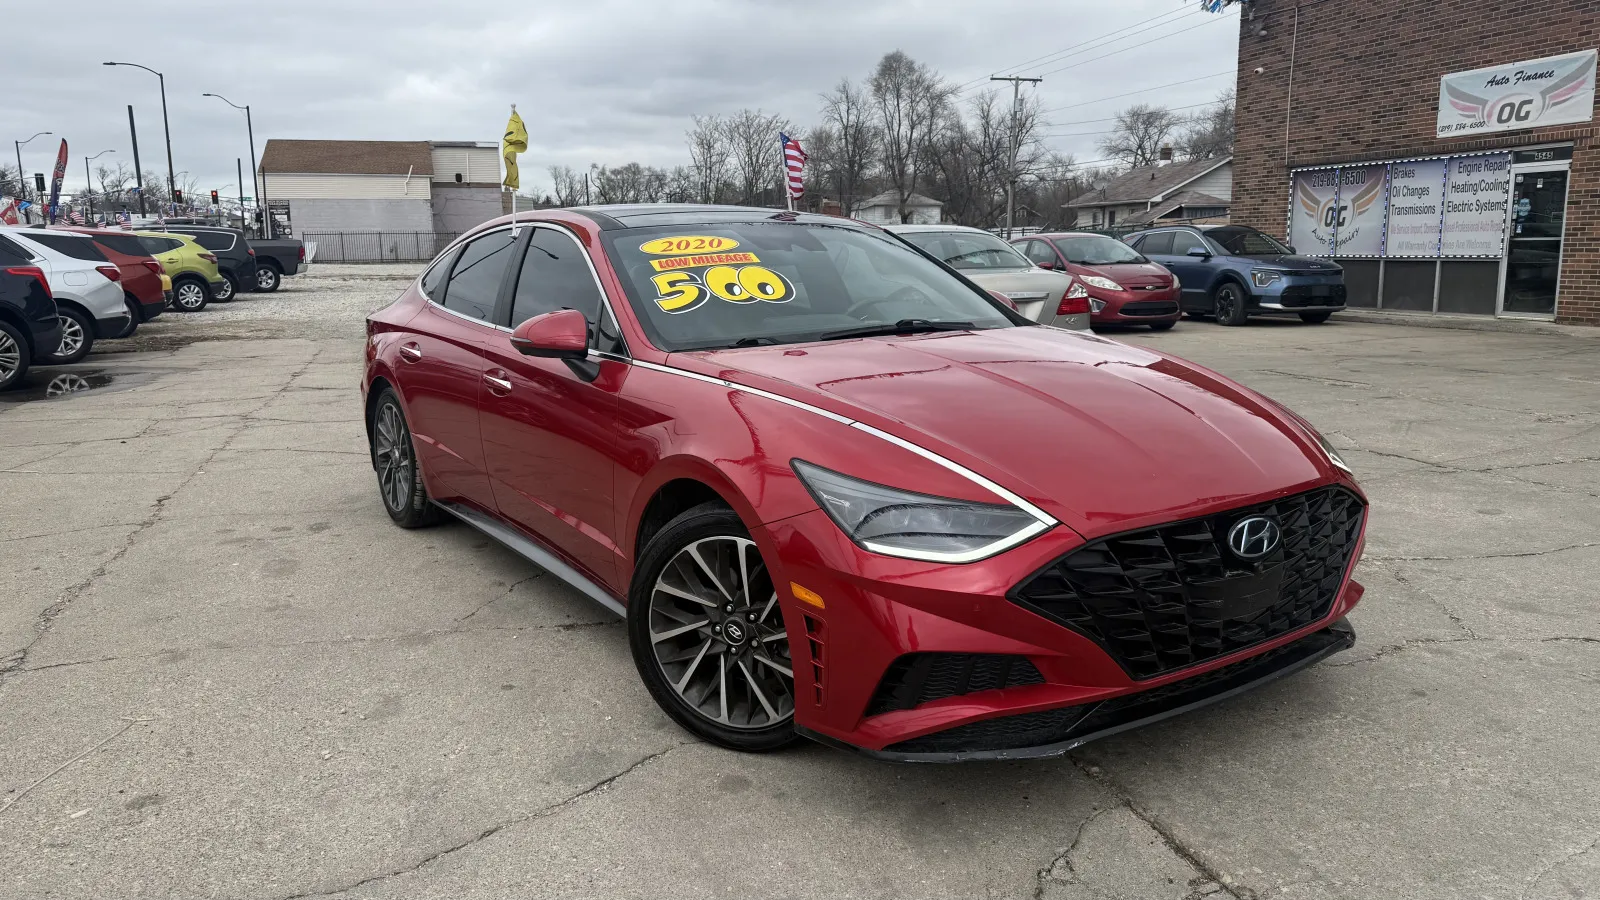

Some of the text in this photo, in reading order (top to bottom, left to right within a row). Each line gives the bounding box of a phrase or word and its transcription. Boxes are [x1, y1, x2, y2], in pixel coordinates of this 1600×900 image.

[1484, 70, 1555, 88] Auto Finance
[1497, 99, 1534, 124] OG
[1454, 120, 1486, 130] 884-6500
[1393, 167, 1415, 180] Brakes
[1458, 158, 1508, 176] Engine Repair
[1312, 170, 1366, 187] 219-88-6500
[1451, 178, 1507, 195] Heating/Cooling
[1392, 185, 1430, 199] Oil Changes
[1391, 203, 1436, 216] Transmissions
[1447, 200, 1473, 213] Electric
[1475, 199, 1506, 214] Systems
[1324, 205, 1348, 228] OG
[1312, 228, 1327, 244] Auto
[660, 238, 723, 252] 2020
[658, 253, 753, 270] LOW MILEAGE
[650, 265, 796, 314] 500
